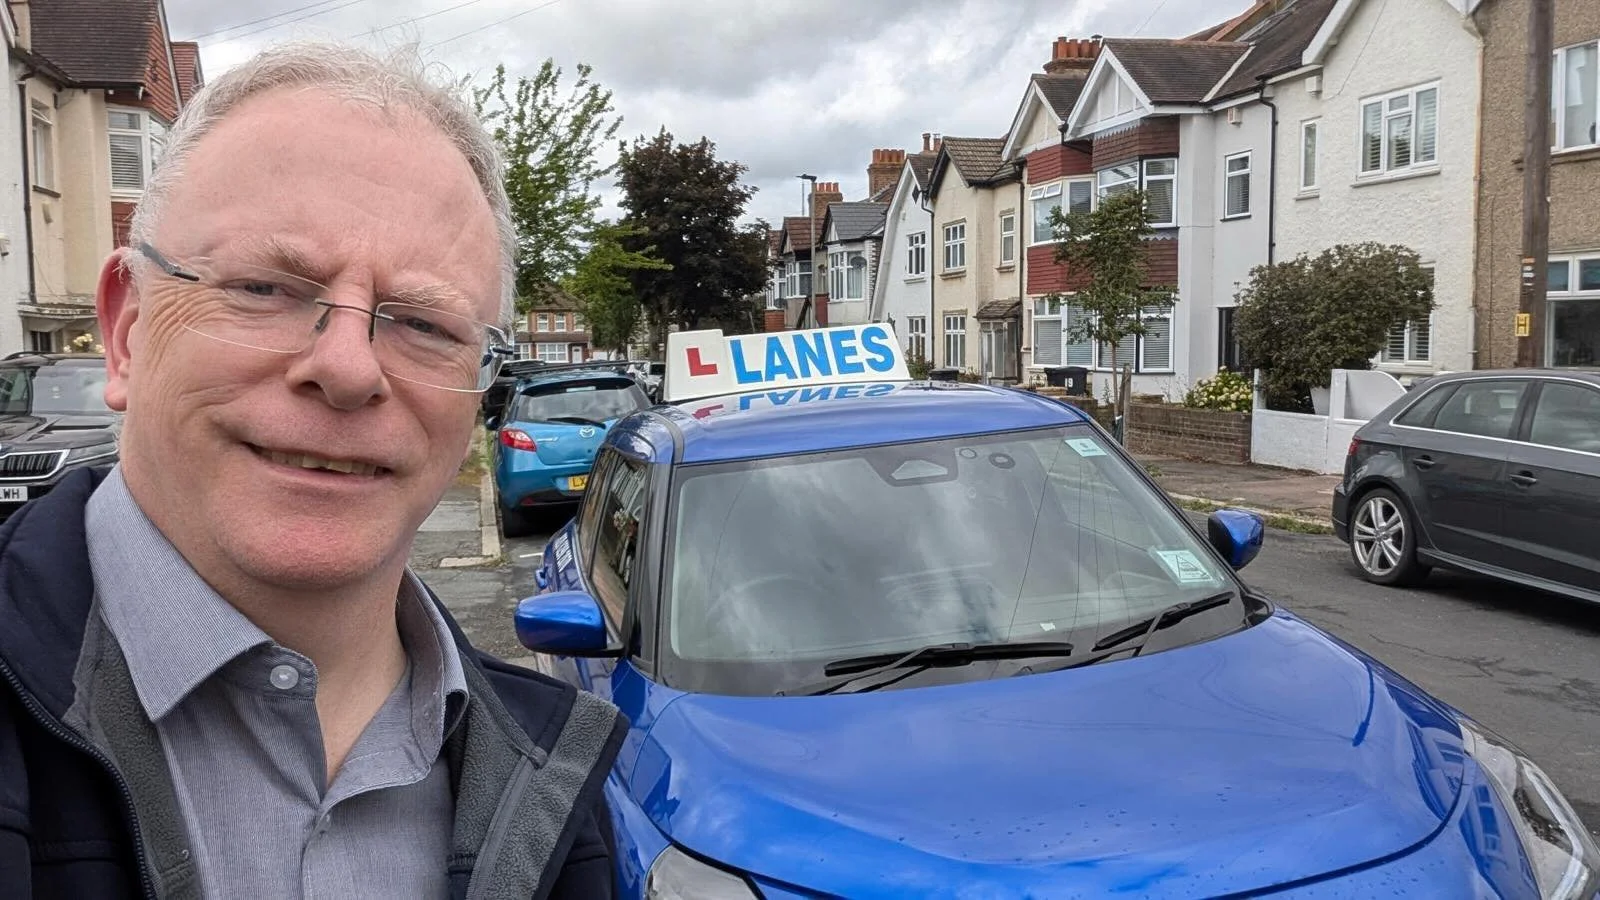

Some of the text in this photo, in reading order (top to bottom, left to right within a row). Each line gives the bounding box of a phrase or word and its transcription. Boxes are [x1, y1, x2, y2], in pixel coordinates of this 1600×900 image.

[1516, 315, 1527, 335] H
[686, 347, 719, 377] L
[729, 326, 895, 385] LANES
[1064, 377, 1074, 388] 19
